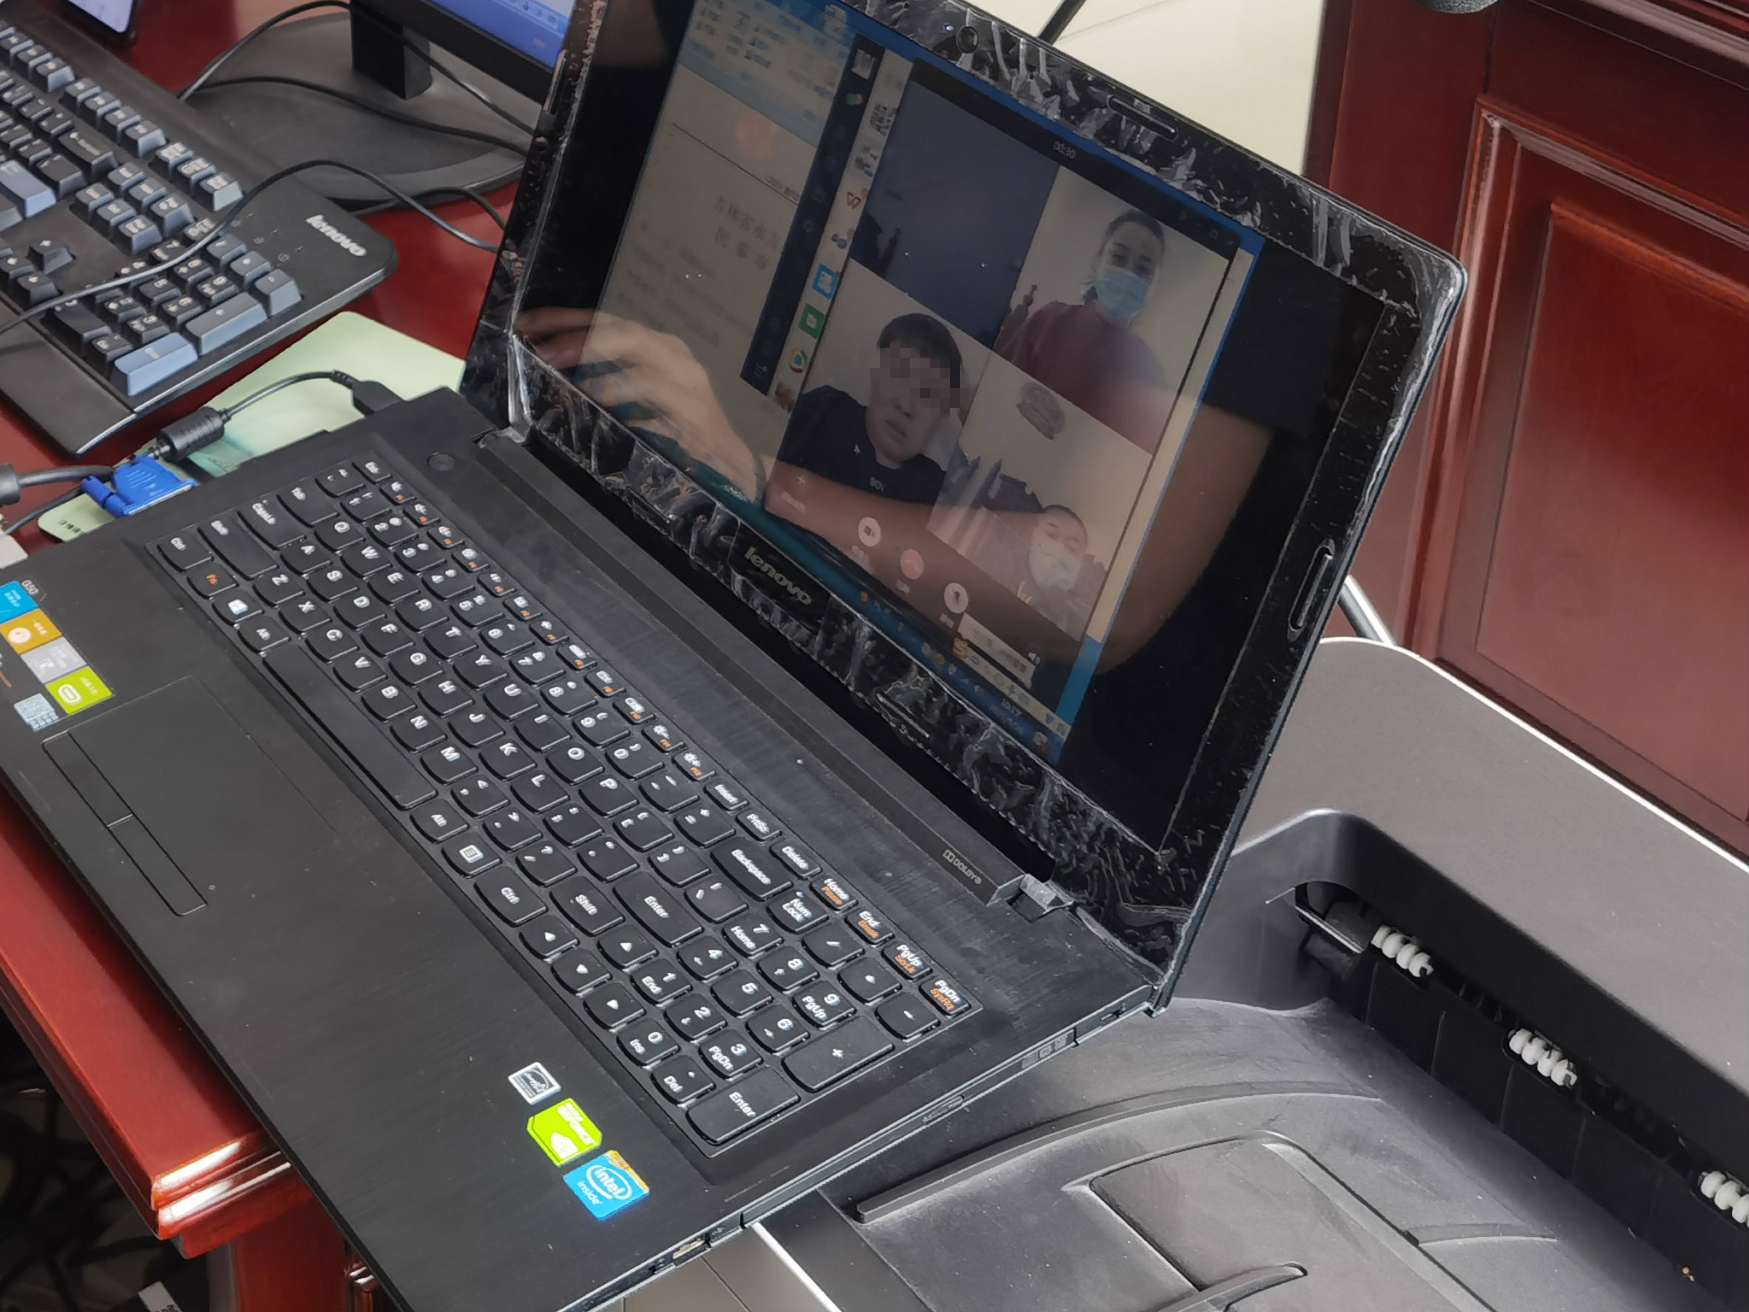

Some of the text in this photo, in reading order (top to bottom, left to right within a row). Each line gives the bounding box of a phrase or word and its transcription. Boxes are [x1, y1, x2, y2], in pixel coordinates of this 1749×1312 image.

[306, 214, 367, 256] lenovo
[301, 545, 315, 555] A
[361, 546, 380, 560] W
[271, 574, 289, 586] Z
[326, 570, 343, 581] S
[387, 572, 404, 584] E
[744, 546, 813, 606] lenovo
[298, 601, 315, 613] X
[353, 596, 370, 608] D
[415, 599, 432, 611] R
[326, 629, 343, 641] C
[380, 623, 398, 633] F
[446, 626, 463, 637] T
[355, 656, 371, 668] V
[410, 652, 427, 666] G
[475, 654, 492, 666] Y
[381, 685, 399, 698] B
[438, 680, 457, 694] H
[504, 683, 522, 696] U
[549, 686, 564, 697] 8
[410, 715, 429, 729] N
[469, 713, 486, 723] J
[580, 716, 596, 728] 9
[440, 746, 461, 762] M
[499, 742, 518, 756] K
[567, 747, 585, 760] O
[531, 774, 546, 787] L
[600, 778, 618, 789] P
[431, 813, 448, 827] Alt
[781, 845, 809, 870] Delete
[731, 848, 771, 885] Backspace
[501, 887, 520, 905] Ctrl
[823, 878, 851, 902] Home
[575, 894, 599, 916] Shift
[644, 895, 670, 919] Enter
[789, 897, 813, 919] Num
[781, 902, 804, 923] Lock
[859, 910, 882, 929] End
[753, 923, 770, 934] 7
[730, 925, 757, 950] Home
[708, 949, 724, 960] 4
[897, 944, 924, 968] PgUp
[787, 958, 804, 971] 8
[641, 975, 663, 995] End
[741, 982, 758, 994] 5
[934, 979, 962, 1004] PgDn
[824, 993, 841, 1007] 9
[694, 1006, 712, 1019] 2
[802, 995, 828, 1021] PgUp
[777, 1018, 794, 1031] 6
[629, 1038, 646, 1054] Ins
[731, 1043, 747, 1056] 3
[708, 1045, 735, 1071] PgDn
[663, 1075, 683, 1093] Del
[729, 1091, 757, 1118] Enter
[594, 1166, 626, 1198] intel
[577, 1181, 602, 1205] inside
